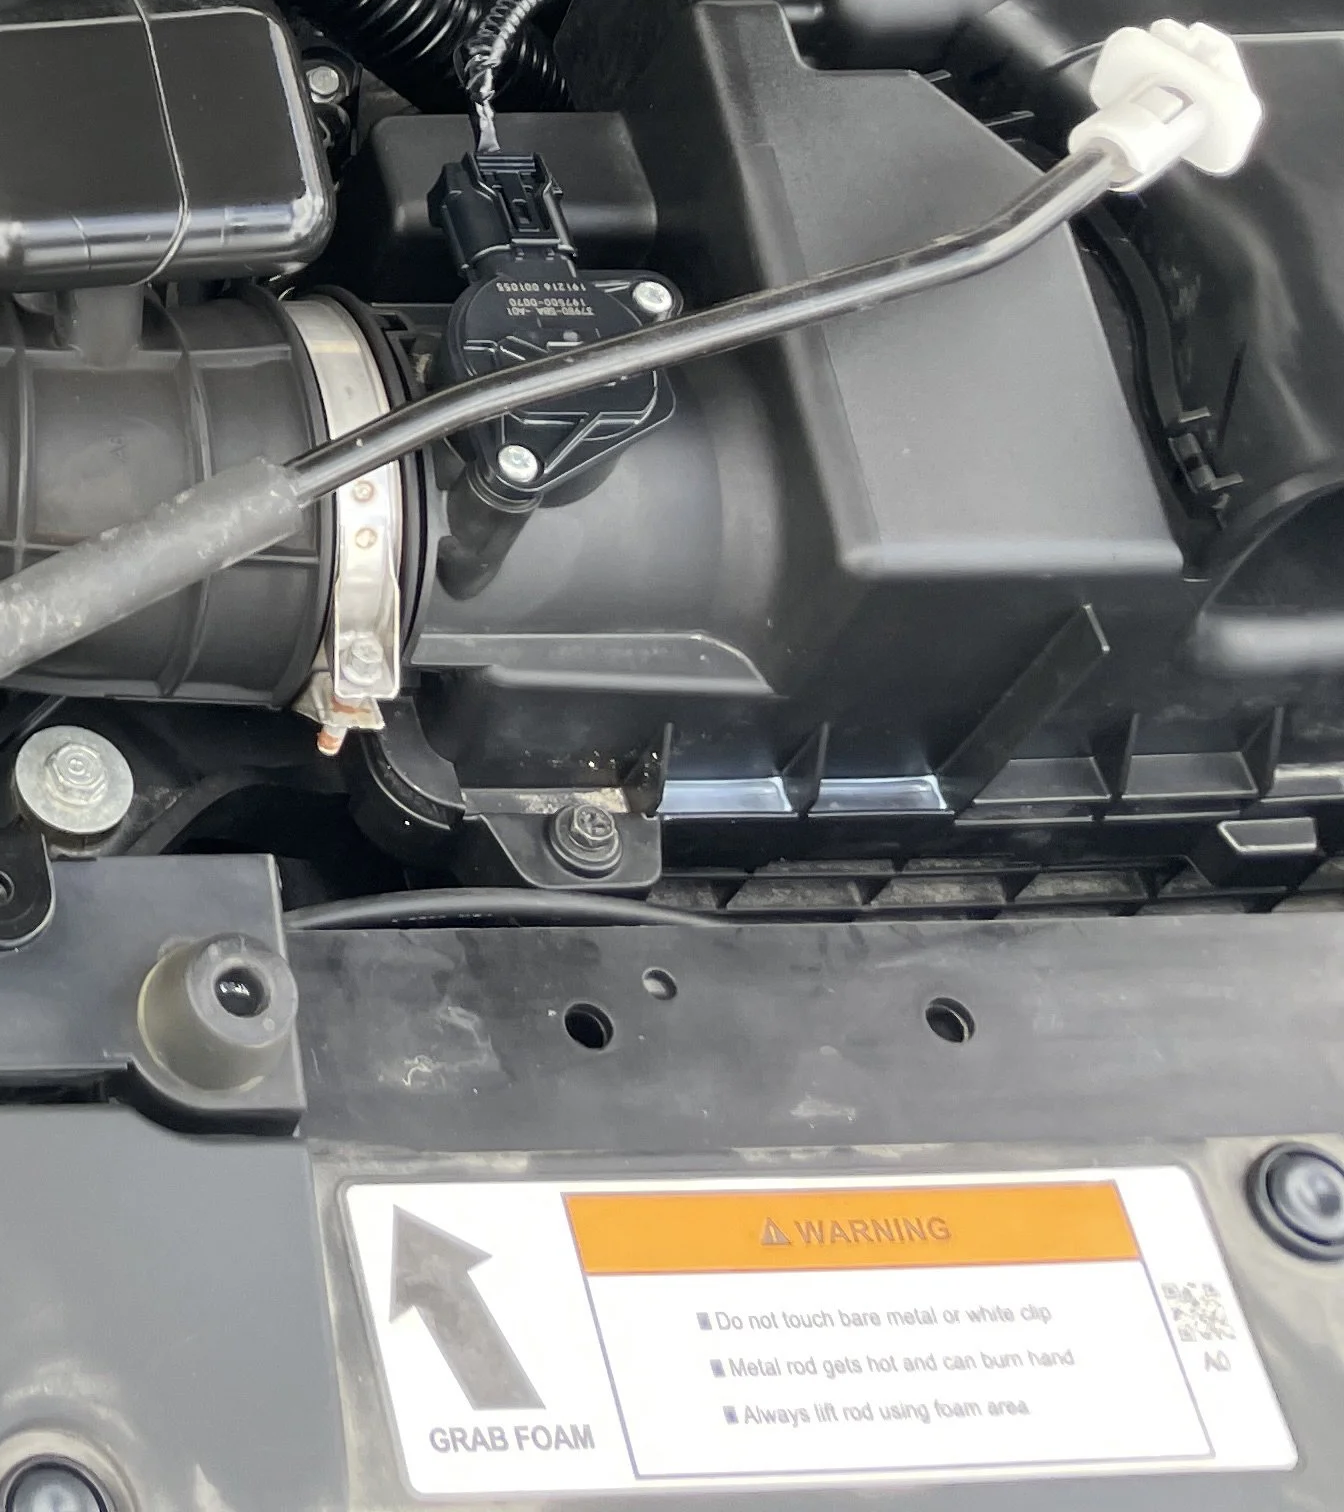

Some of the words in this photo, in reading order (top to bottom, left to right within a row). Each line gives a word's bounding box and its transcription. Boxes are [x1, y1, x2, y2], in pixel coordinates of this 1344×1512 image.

[794, 1216, 952, 1246] WARNING
[715, 1311, 743, 1330] Do
[748, 1311, 779, 1330] not
[782, 1310, 834, 1329] touch
[838, 1308, 881, 1327] bare
[887, 1306, 937, 1326] metal
[943, 1307, 960, 1324] or
[965, 1304, 1015, 1323] white
[1020, 1302, 1052, 1324] clip
[728, 1356, 781, 1377] Metal
[787, 1355, 818, 1376] rod
[823, 1356, 863, 1379] gets
[867, 1354, 899, 1373] hot
[903, 1353, 937, 1372] and
[943, 1355, 977, 1371] can
[1028, 1348, 1075, 1367] hand
[744, 1404, 810, 1428] Always
[814, 1402, 838, 1423] lift
[843, 1401, 874, 1422] rod
[878, 1401, 931, 1424] using
[934, 1398, 982, 1419] foam
[987, 1399, 1030, 1416] area
[430, 1424, 509, 1454] GRAB
[513, 1423, 596, 1453] FOAM
